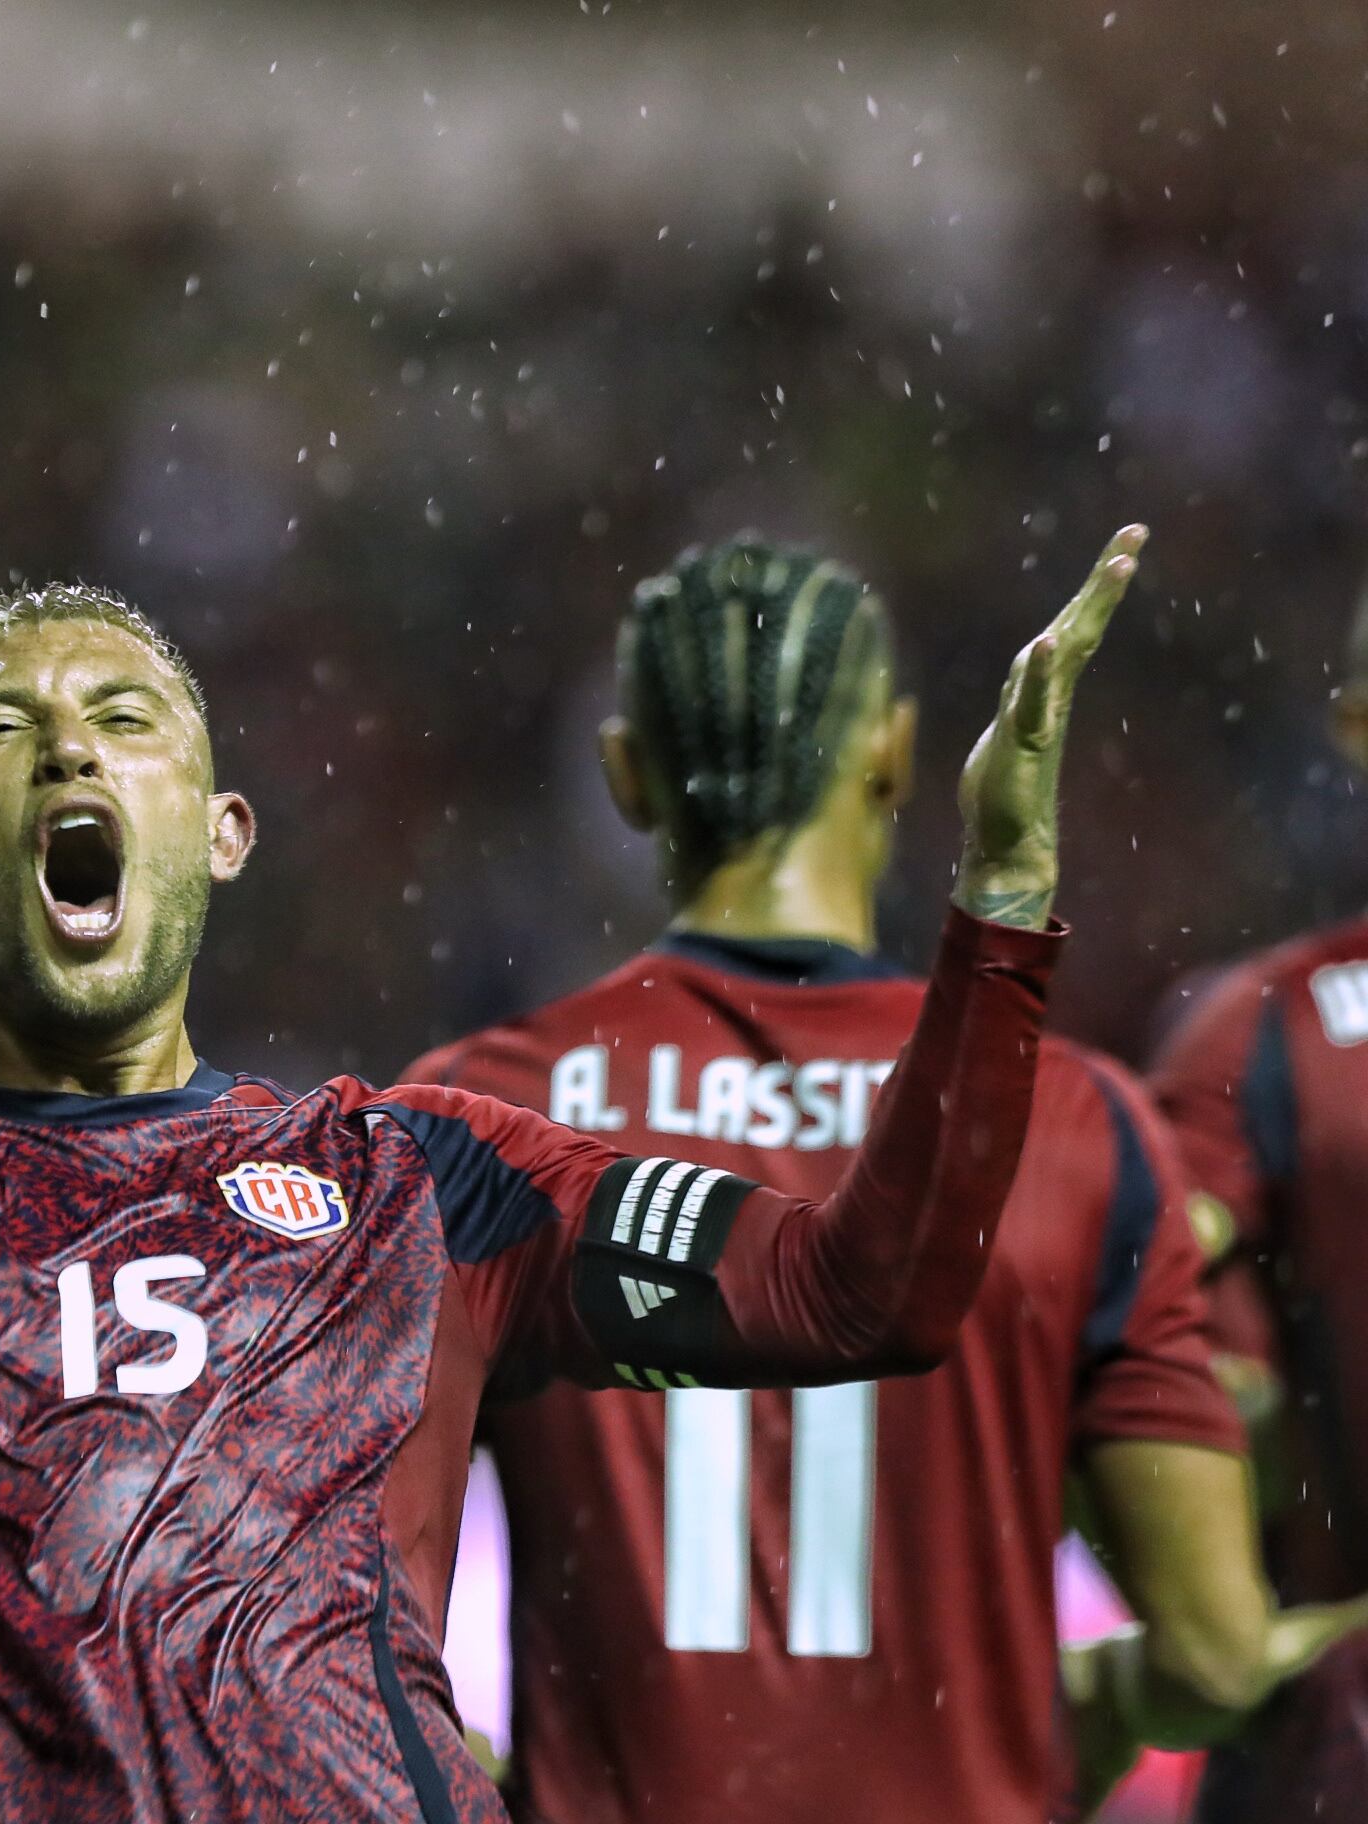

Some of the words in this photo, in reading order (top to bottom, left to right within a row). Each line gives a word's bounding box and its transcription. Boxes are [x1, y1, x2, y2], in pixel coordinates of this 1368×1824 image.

[548, 1043, 627, 1132] A.
[247, 1178, 319, 1222] CR
[57, 1254, 208, 1399] 15
[665, 1385, 878, 1657] 11
